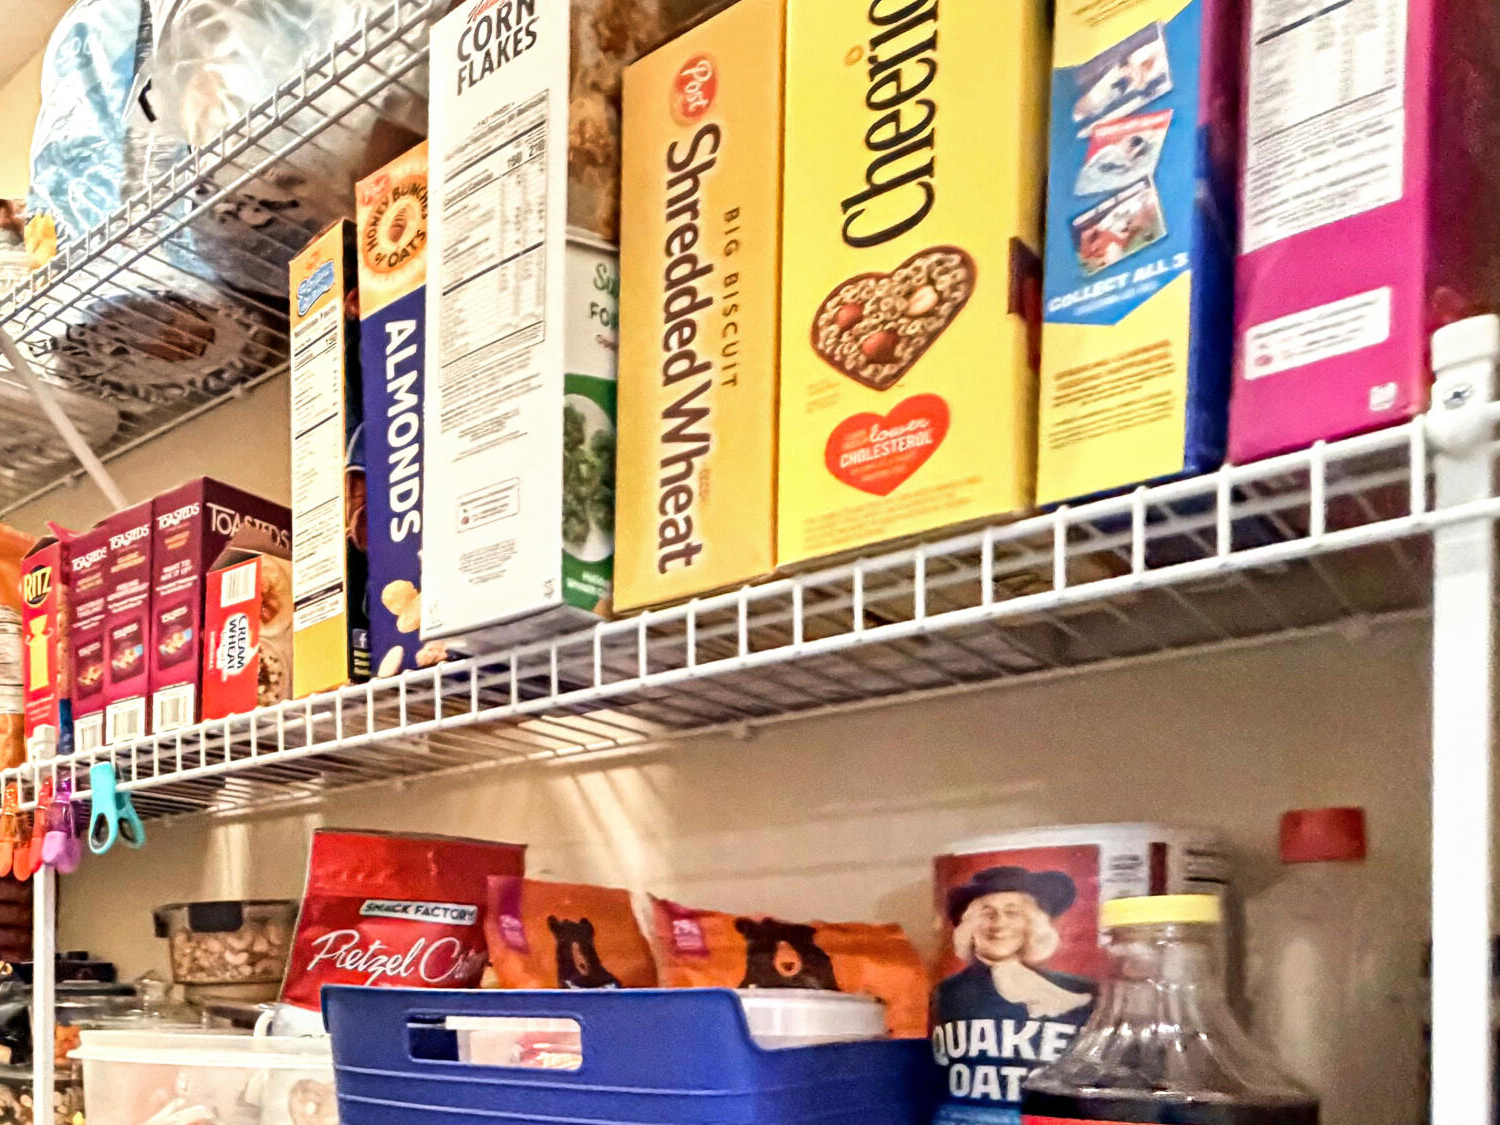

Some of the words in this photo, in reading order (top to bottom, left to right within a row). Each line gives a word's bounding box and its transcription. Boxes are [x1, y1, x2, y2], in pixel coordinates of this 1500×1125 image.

[457, 0, 535, 62] CORN
[457, 16, 540, 96] FLAKES
[681, 60, 713, 112] Post
[663, 122, 721, 387] Shredded
[723, 207, 741, 257] BIG
[720, 271, 740, 388] BISCUIT
[385, 319, 421, 543] ALMONDS
[839, 429, 933, 469] CHOLESTEROL
[657, 379, 713, 575] Wheat
[23, 565, 53, 603] RITZ
[227, 618, 238, 669] WHEAT
[236, 615, 248, 669] CREAM
[365, 903, 410, 914] SNACK
[413, 907, 476, 921] FACTORY
[307, 929, 427, 987] Pretzel
[932, 1018, 1079, 1067] QUAKE
